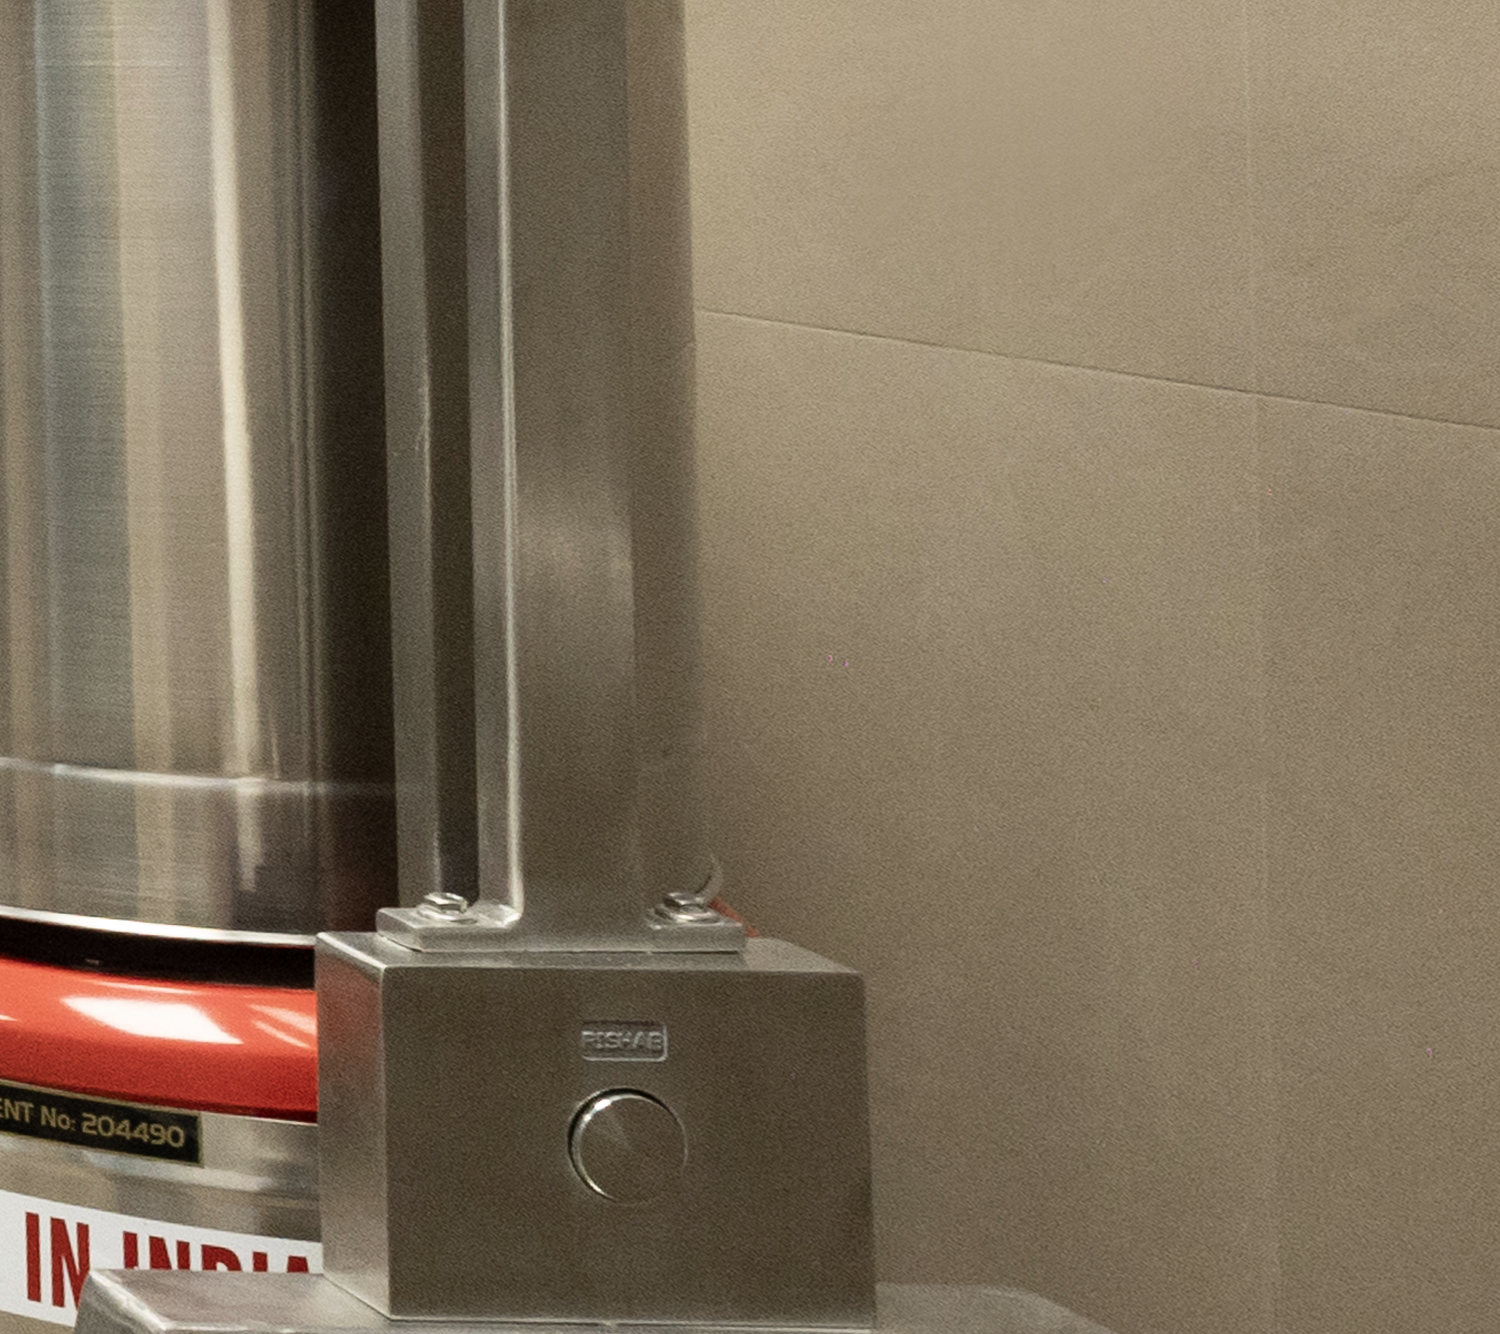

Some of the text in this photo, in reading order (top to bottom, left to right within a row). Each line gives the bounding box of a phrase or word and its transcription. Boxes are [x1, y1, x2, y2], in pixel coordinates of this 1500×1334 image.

[40, 1105, 76, 1131] No:
[82, 1112, 185, 1148] 204490
[25, 1211, 90, 1310] IN
